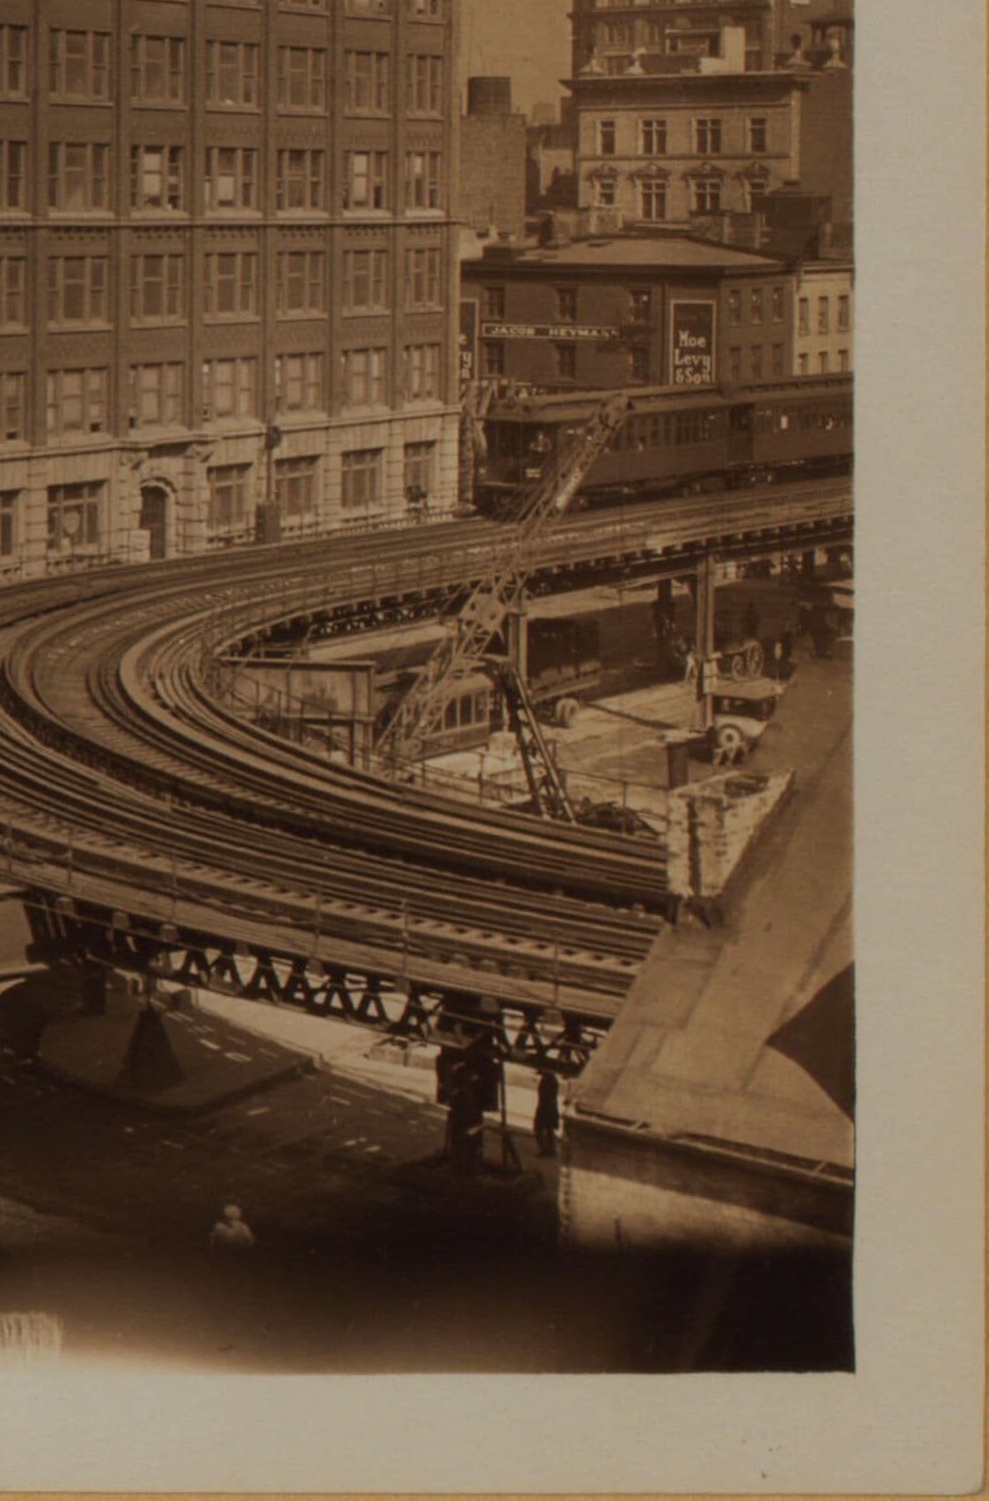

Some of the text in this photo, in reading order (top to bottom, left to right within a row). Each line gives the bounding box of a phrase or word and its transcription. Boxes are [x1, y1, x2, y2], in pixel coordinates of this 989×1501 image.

[491, 327, 534, 335] JACOB
[678, 330, 706, 348] Moe
[674, 348, 711, 372] Levy
